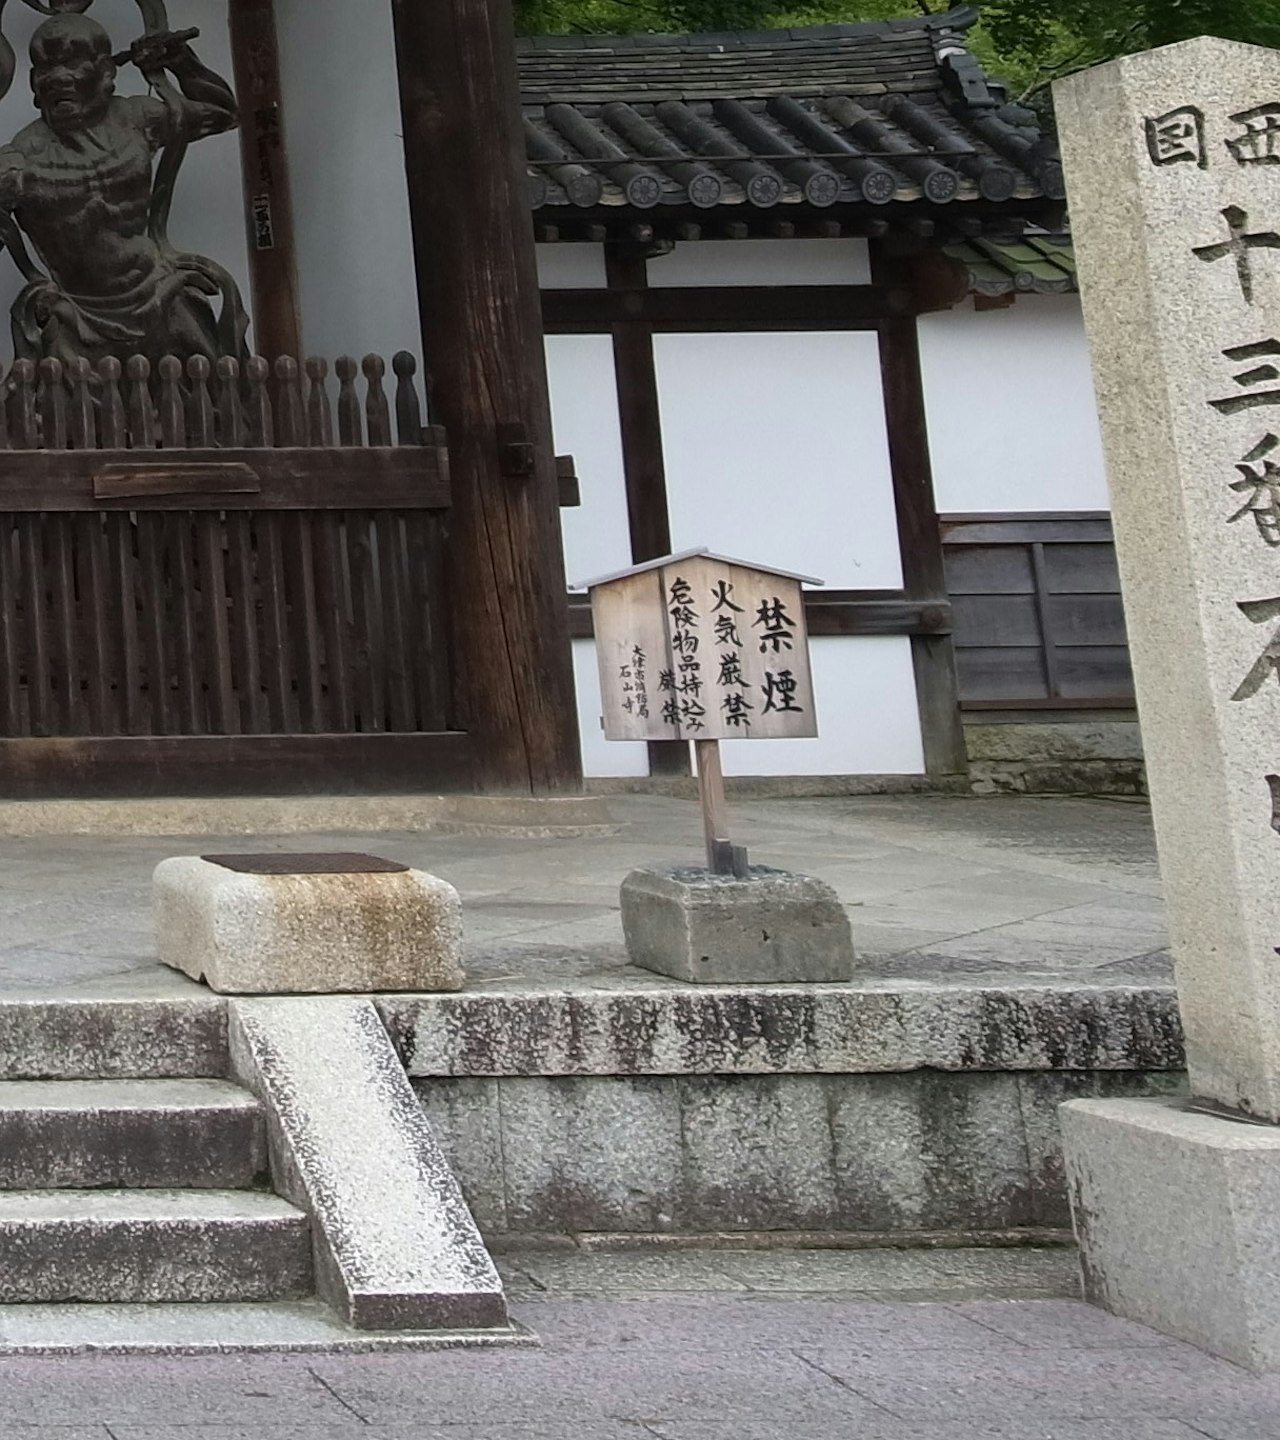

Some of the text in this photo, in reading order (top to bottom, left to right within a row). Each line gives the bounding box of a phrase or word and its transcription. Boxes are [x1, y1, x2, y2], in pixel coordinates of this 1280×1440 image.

[619, 664, 635, 714] 石山寺
[668, 577, 706, 731] 危険物品持込み
[710, 579, 754, 726] 火気厳禁
[751, 597, 803, 715] 禁煙
